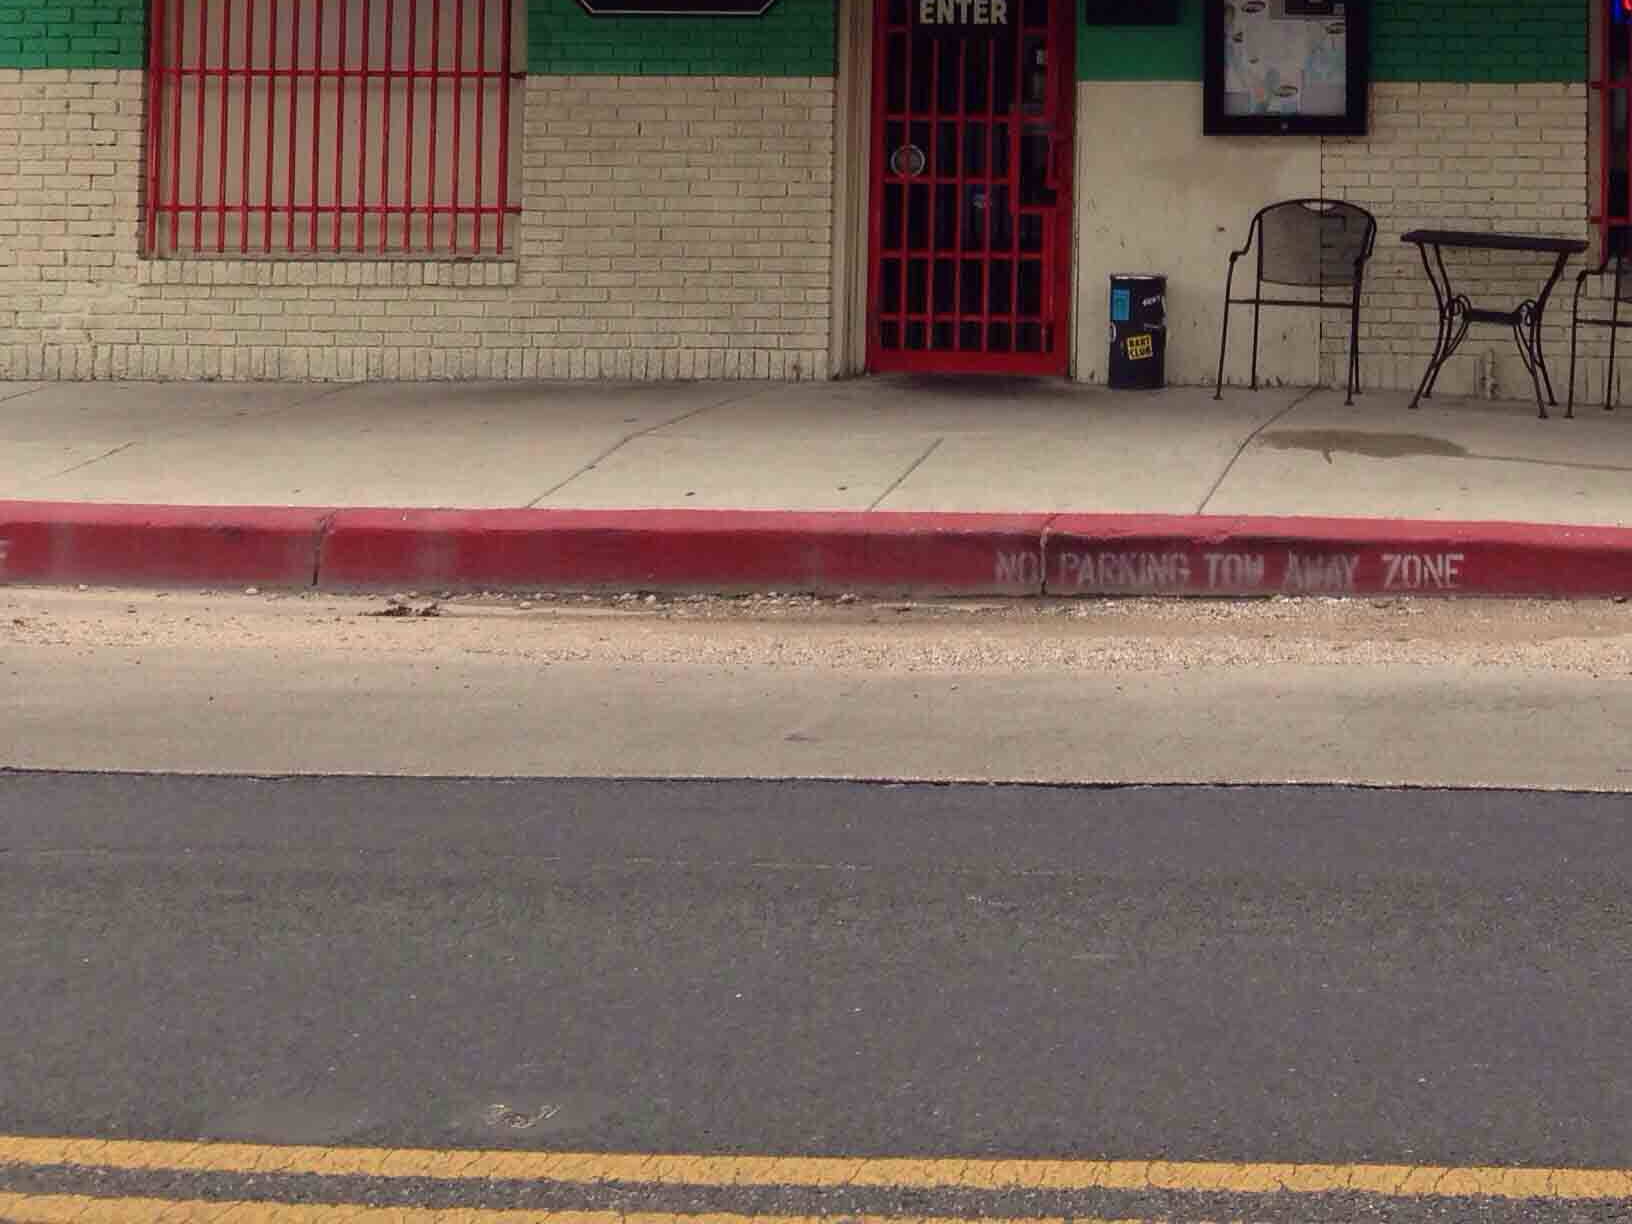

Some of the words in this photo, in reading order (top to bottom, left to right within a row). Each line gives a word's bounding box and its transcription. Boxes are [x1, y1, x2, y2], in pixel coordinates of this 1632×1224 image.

[998, 551, 1041, 584] NO
[1060, 551, 1192, 587] PARKING
[1204, 553, 1266, 588] TOW
[1285, 553, 1360, 589] AWAY
[1383, 553, 1466, 589] ZONE
